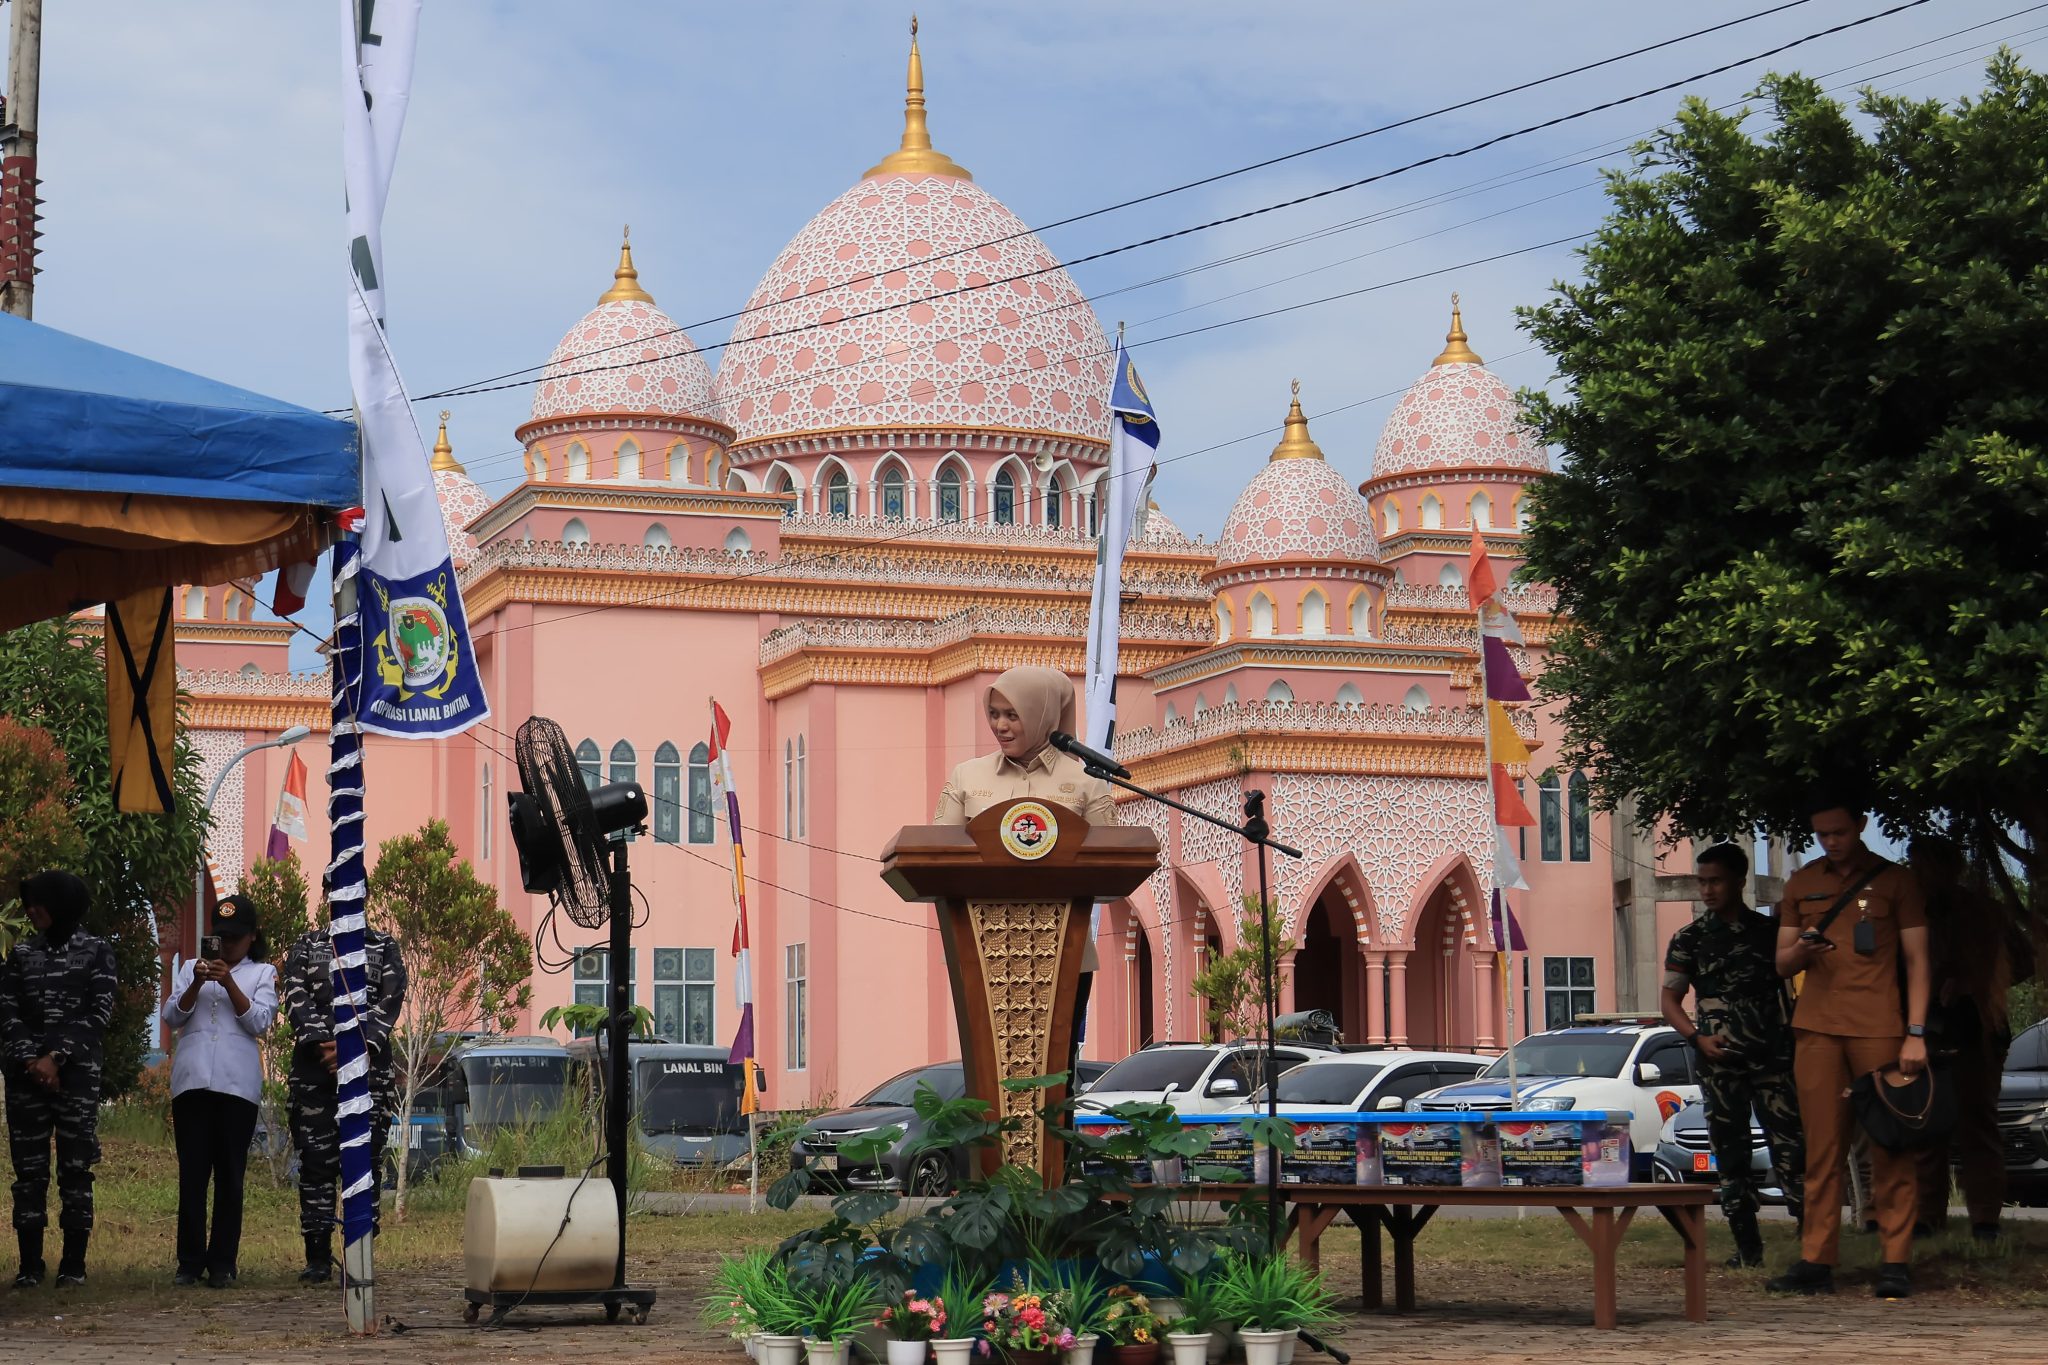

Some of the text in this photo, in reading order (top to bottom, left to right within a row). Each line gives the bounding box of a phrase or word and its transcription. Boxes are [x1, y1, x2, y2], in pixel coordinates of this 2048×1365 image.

[408, 707, 442, 722] LANAL
[443, 693, 471, 718] BINTAN
[486, 1056, 526, 1067] LANAL
[663, 1062, 724, 1074] LANAL BIN
